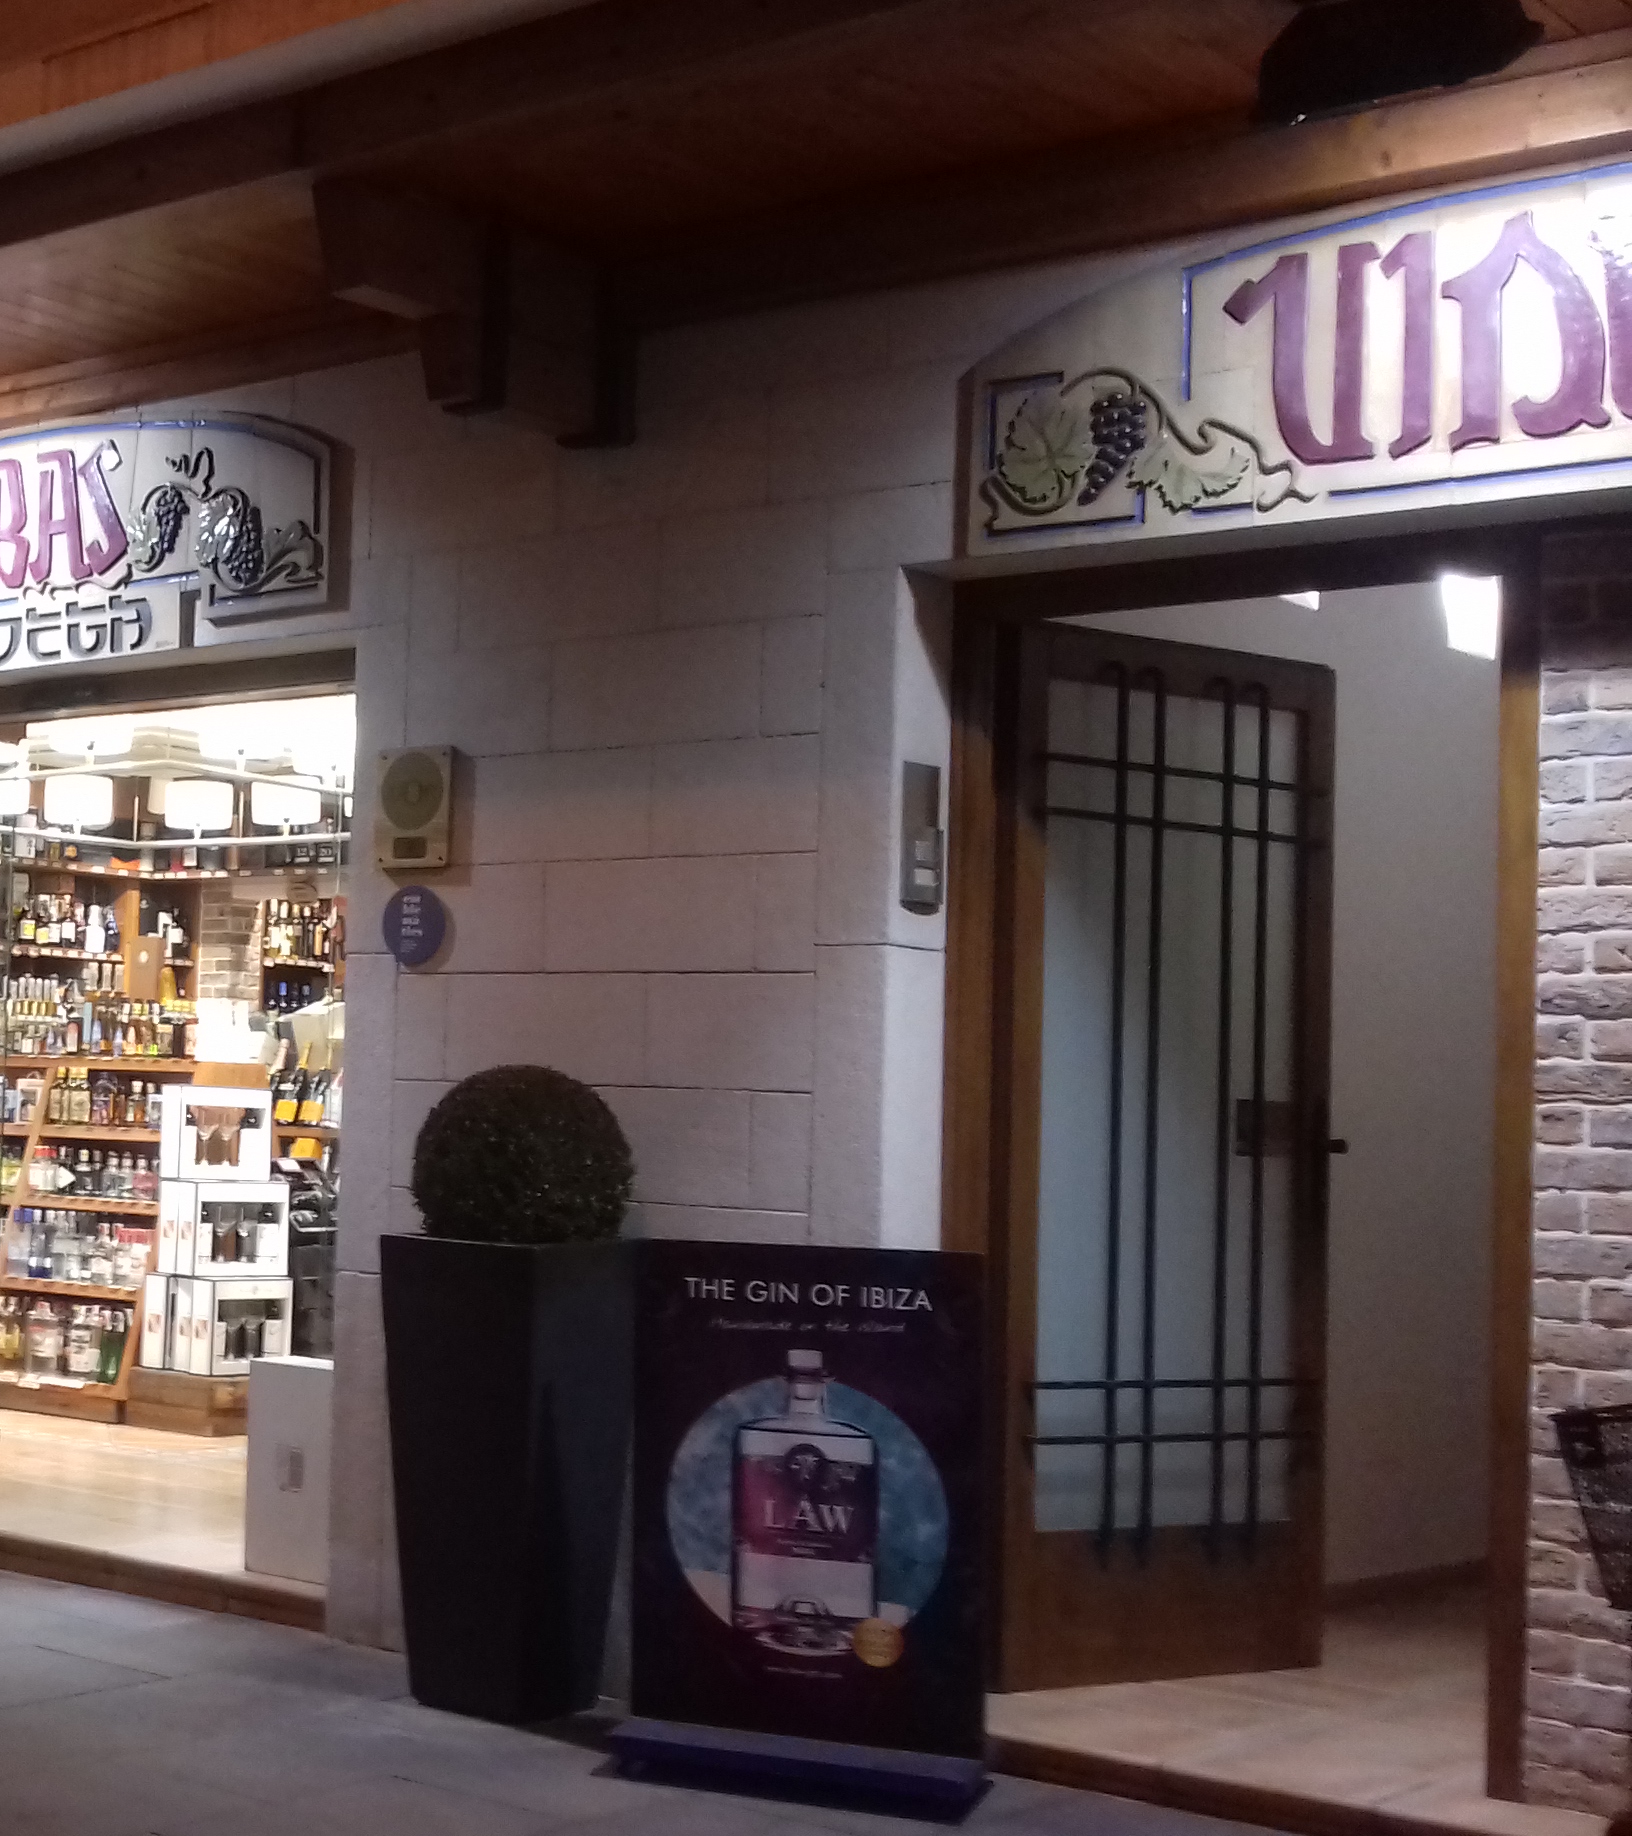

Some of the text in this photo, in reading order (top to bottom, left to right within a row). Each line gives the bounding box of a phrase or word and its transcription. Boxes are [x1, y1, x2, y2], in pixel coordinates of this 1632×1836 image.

[684, 1276, 934, 1312] THE GIN OF IBIZA
[763, 1497, 856, 1535] LAW
